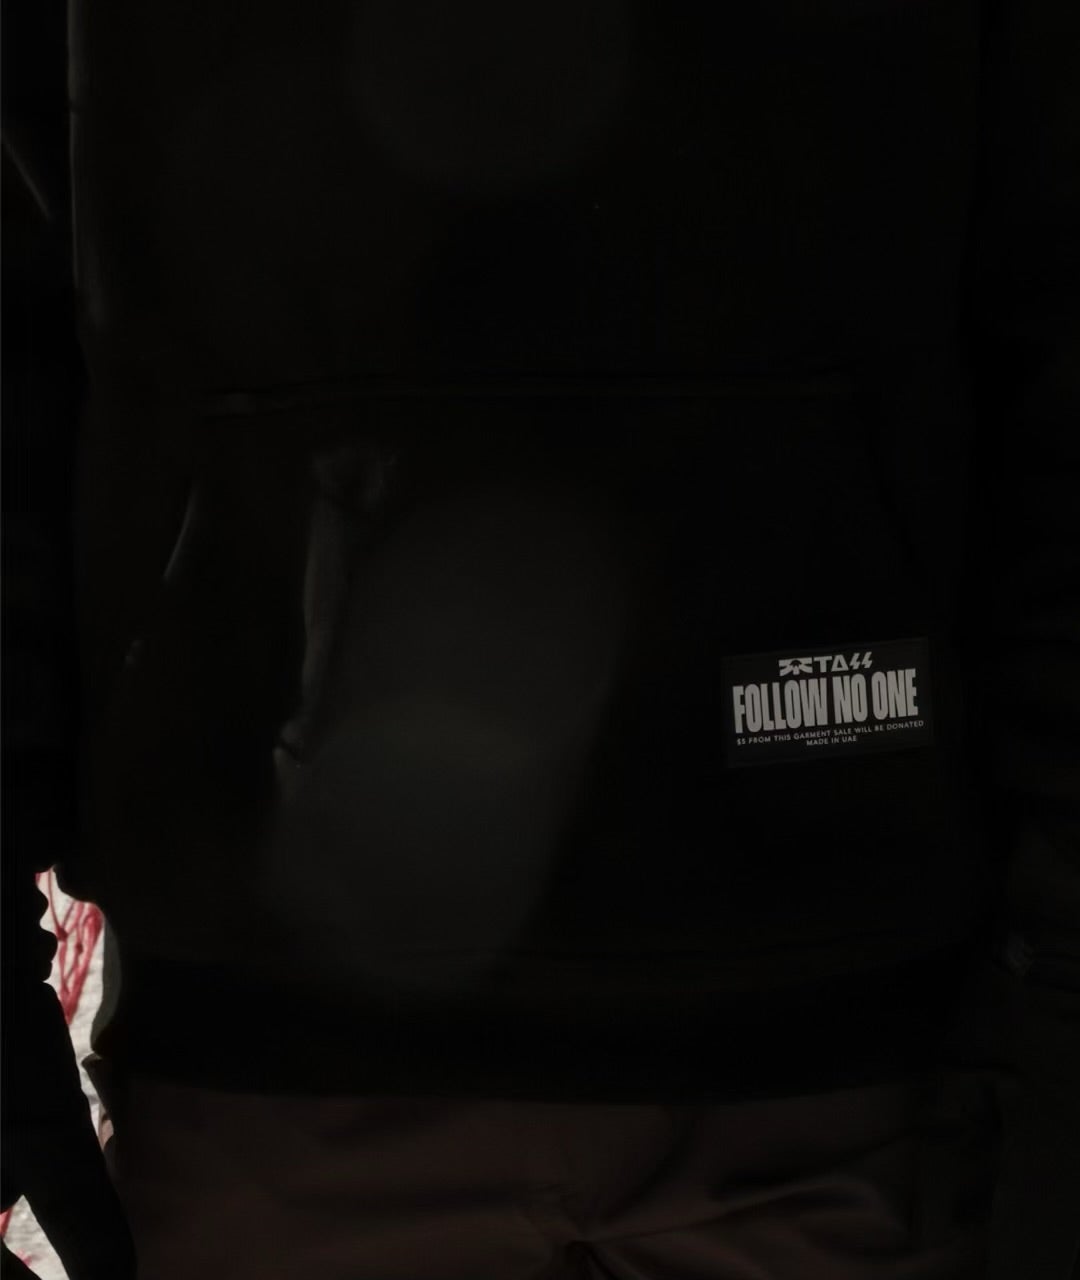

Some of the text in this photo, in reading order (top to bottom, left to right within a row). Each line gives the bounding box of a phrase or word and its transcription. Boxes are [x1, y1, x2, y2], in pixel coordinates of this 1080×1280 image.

[732, 668, 919, 734] FOLLOW NO ONE
[748, 735, 771, 744] FROM
[774, 733, 791, 742] THIS
[793, 730, 831, 740] GARMENT
[833, 727, 852, 736] SALE
[854, 725, 872, 734] WILL
[874, 724, 885, 732] BE
[886, 720, 925, 730] DONATED
[806, 734, 857, 747] MADE IN UAE
